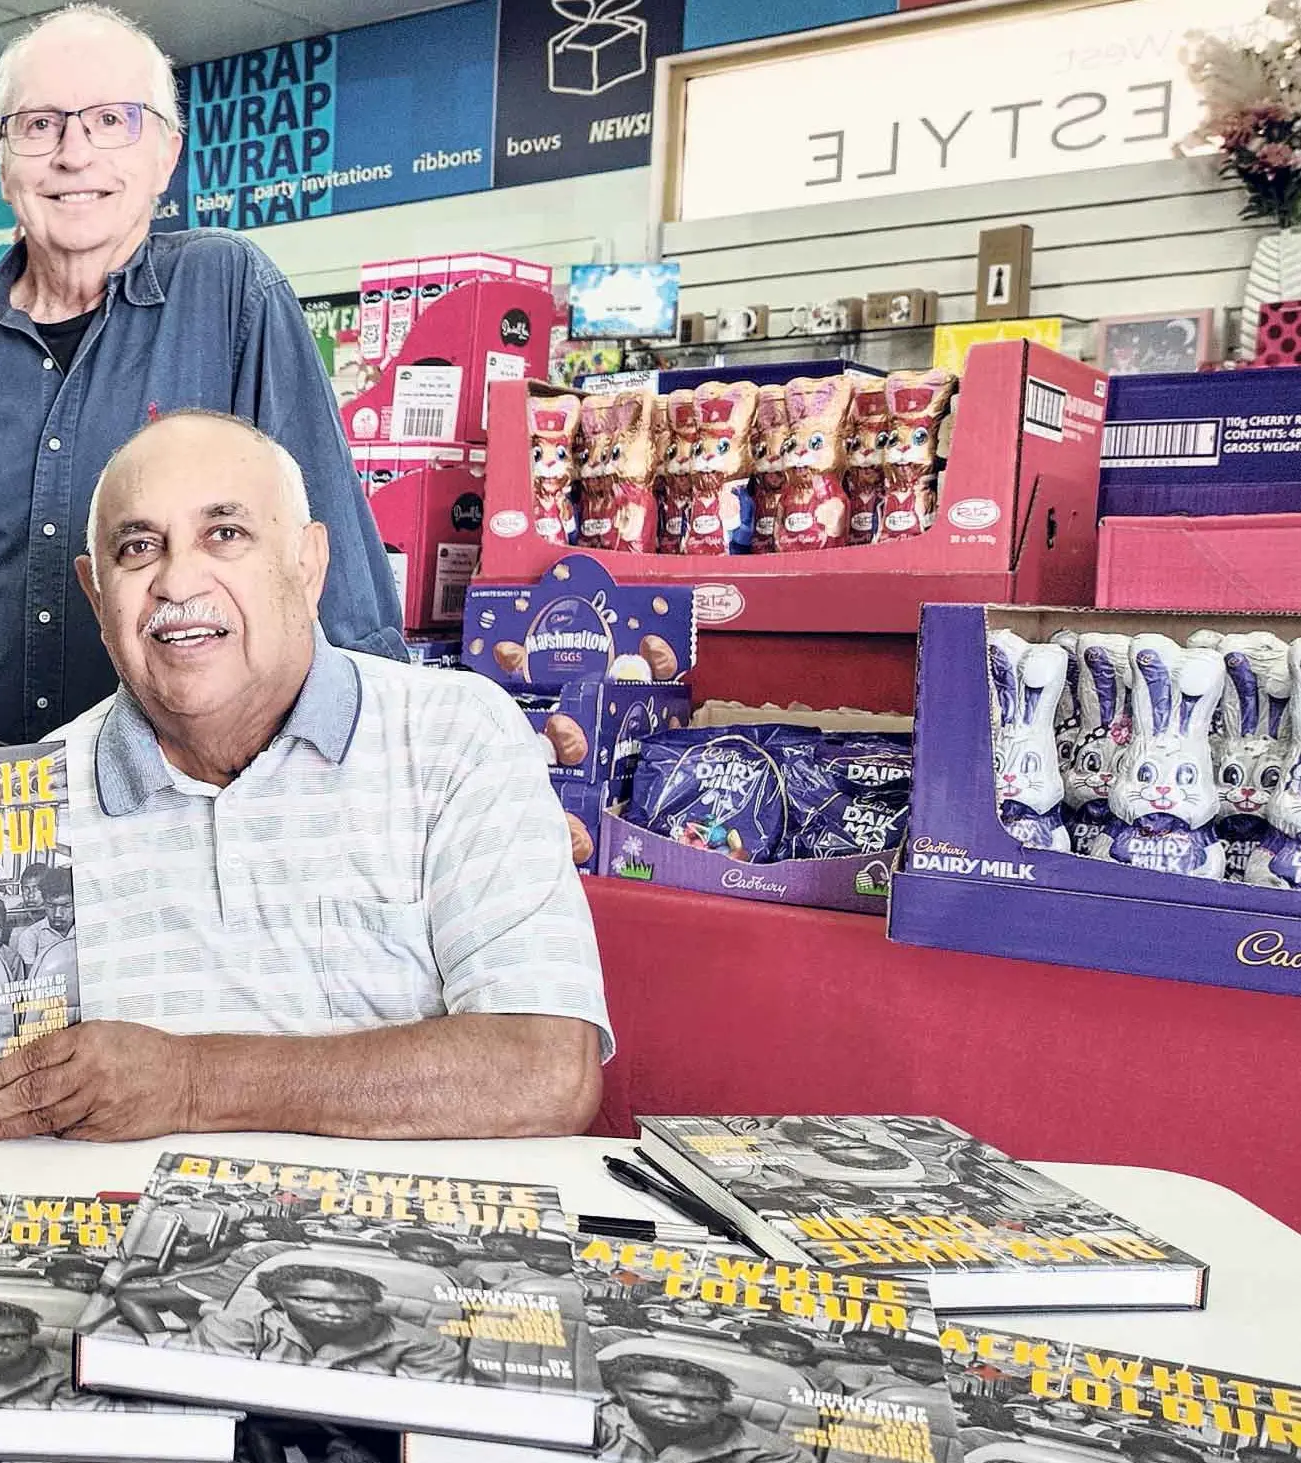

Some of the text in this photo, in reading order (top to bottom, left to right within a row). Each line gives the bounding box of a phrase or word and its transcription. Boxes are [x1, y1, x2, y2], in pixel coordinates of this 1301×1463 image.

[200, 36, 333, 103] WRAP
[195, 82, 332, 147] WRAP
[588, 112, 651, 143] NEWS
[506, 133, 562, 157] bows
[193, 128, 331, 191] WRAP
[412, 147, 483, 174] ribbons
[253, 162, 393, 204] party invitations
[195, 191, 234, 212] baby
[1224, 428, 1287, 440] CONTENTS:
[1225, 416, 1248, 430] 110g
[1249, 414, 1294, 427] CHERRY
[1223, 440, 1301, 454] GROSS WEIGH
[526, 630, 613, 655] Marshmallow
[554, 651, 582, 663] EGGS
[695, 761, 763, 782] DAIRY
[698, 778, 749, 796] MILK
[913, 837, 969, 858] Cadbury
[1128, 837, 1190, 857] DAIRY
[912, 854, 1037, 881] DAIRY MILK
[721, 868, 789, 898] Cadbury
[365, 1172, 541, 1207] WHITE
[25, 1199, 120, 1224] WHI
[320, 1191, 541, 1231] COLOUR
[792, 1215, 994, 1241] COLOUR
[715, 1256, 908, 1304] WHITE
[665, 1273, 909, 1331] COLOUR
[472, 1358, 502, 1371] TIM
[1085, 1352, 1301, 1416] WHITE
[1029, 1369, 1301, 1447] COLOUR
